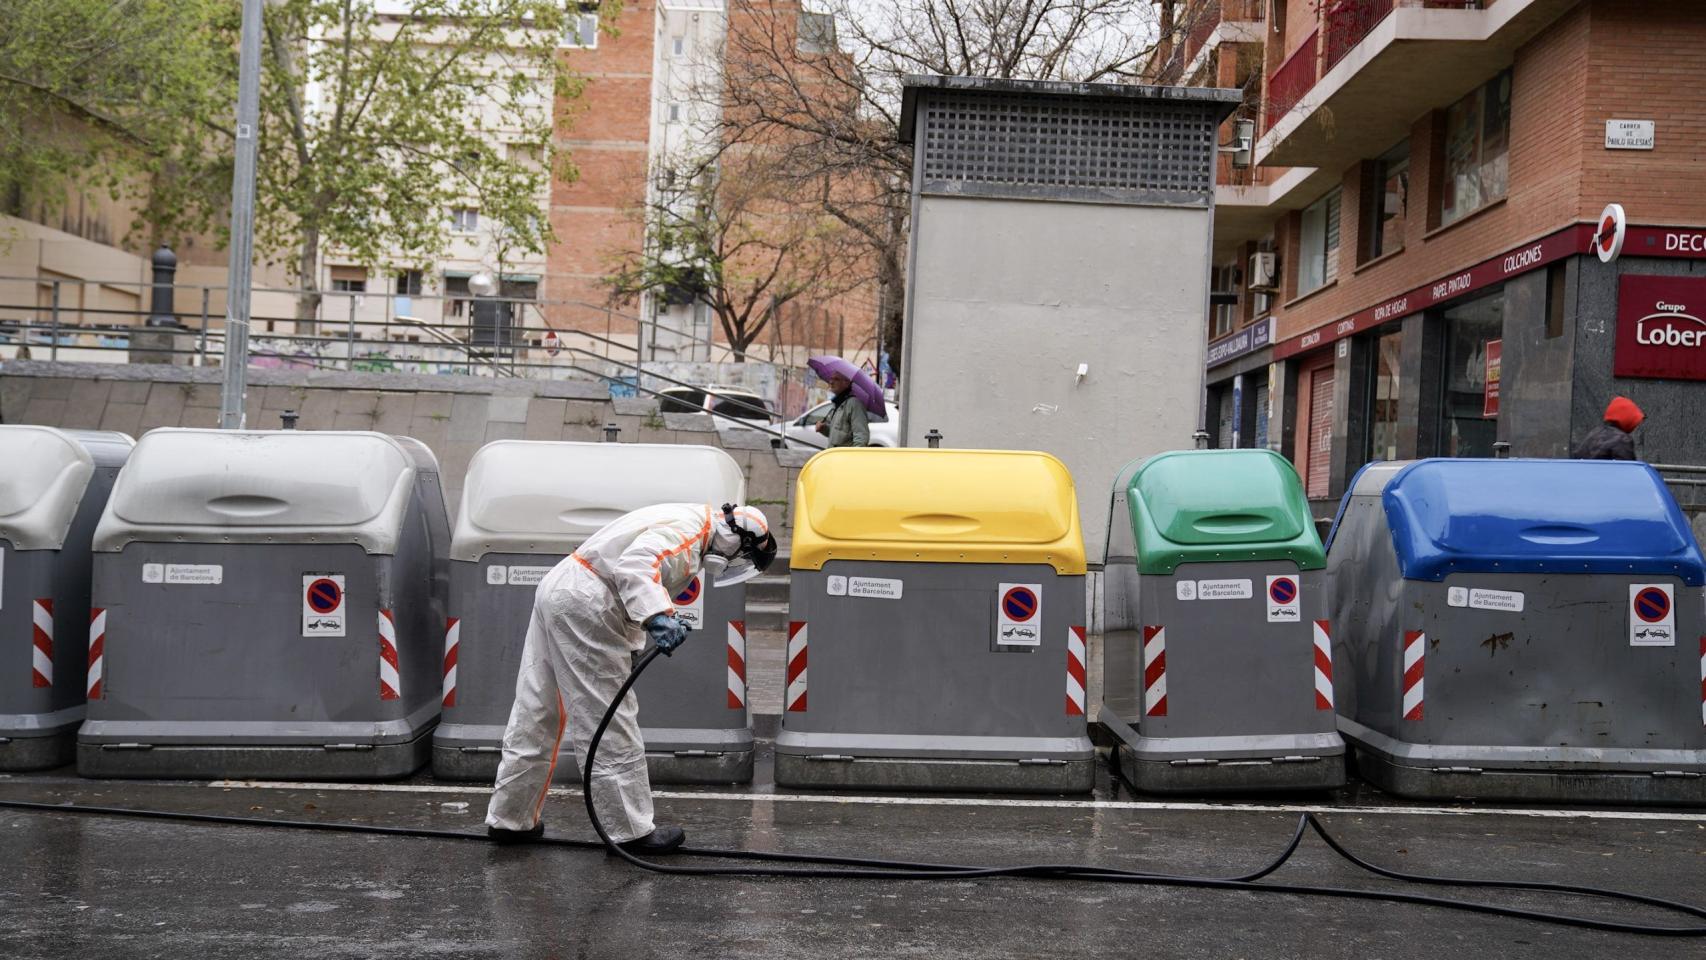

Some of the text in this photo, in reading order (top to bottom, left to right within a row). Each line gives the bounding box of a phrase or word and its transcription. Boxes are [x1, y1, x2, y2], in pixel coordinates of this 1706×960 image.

[1665, 233, 1706, 252] DEC
[1503, 244, 1542, 273] COLCHONES
[1432, 272, 1471, 300] PAPEL PINTADO
[1374, 306, 1386, 321] ROPA
[1391, 297, 1408, 315] HOGAR
[1655, 301, 1686, 313] Grupo
[169, 567, 211, 575] Ajuntament
[853, 580, 891, 589] Ajuntament
[1202, 583, 1241, 591] Ajuntament
[862, 588, 895, 596] Barcelona
[1474, 591, 1513, 602] Ajuntament
[1483, 599, 1517, 609] Barcelona
